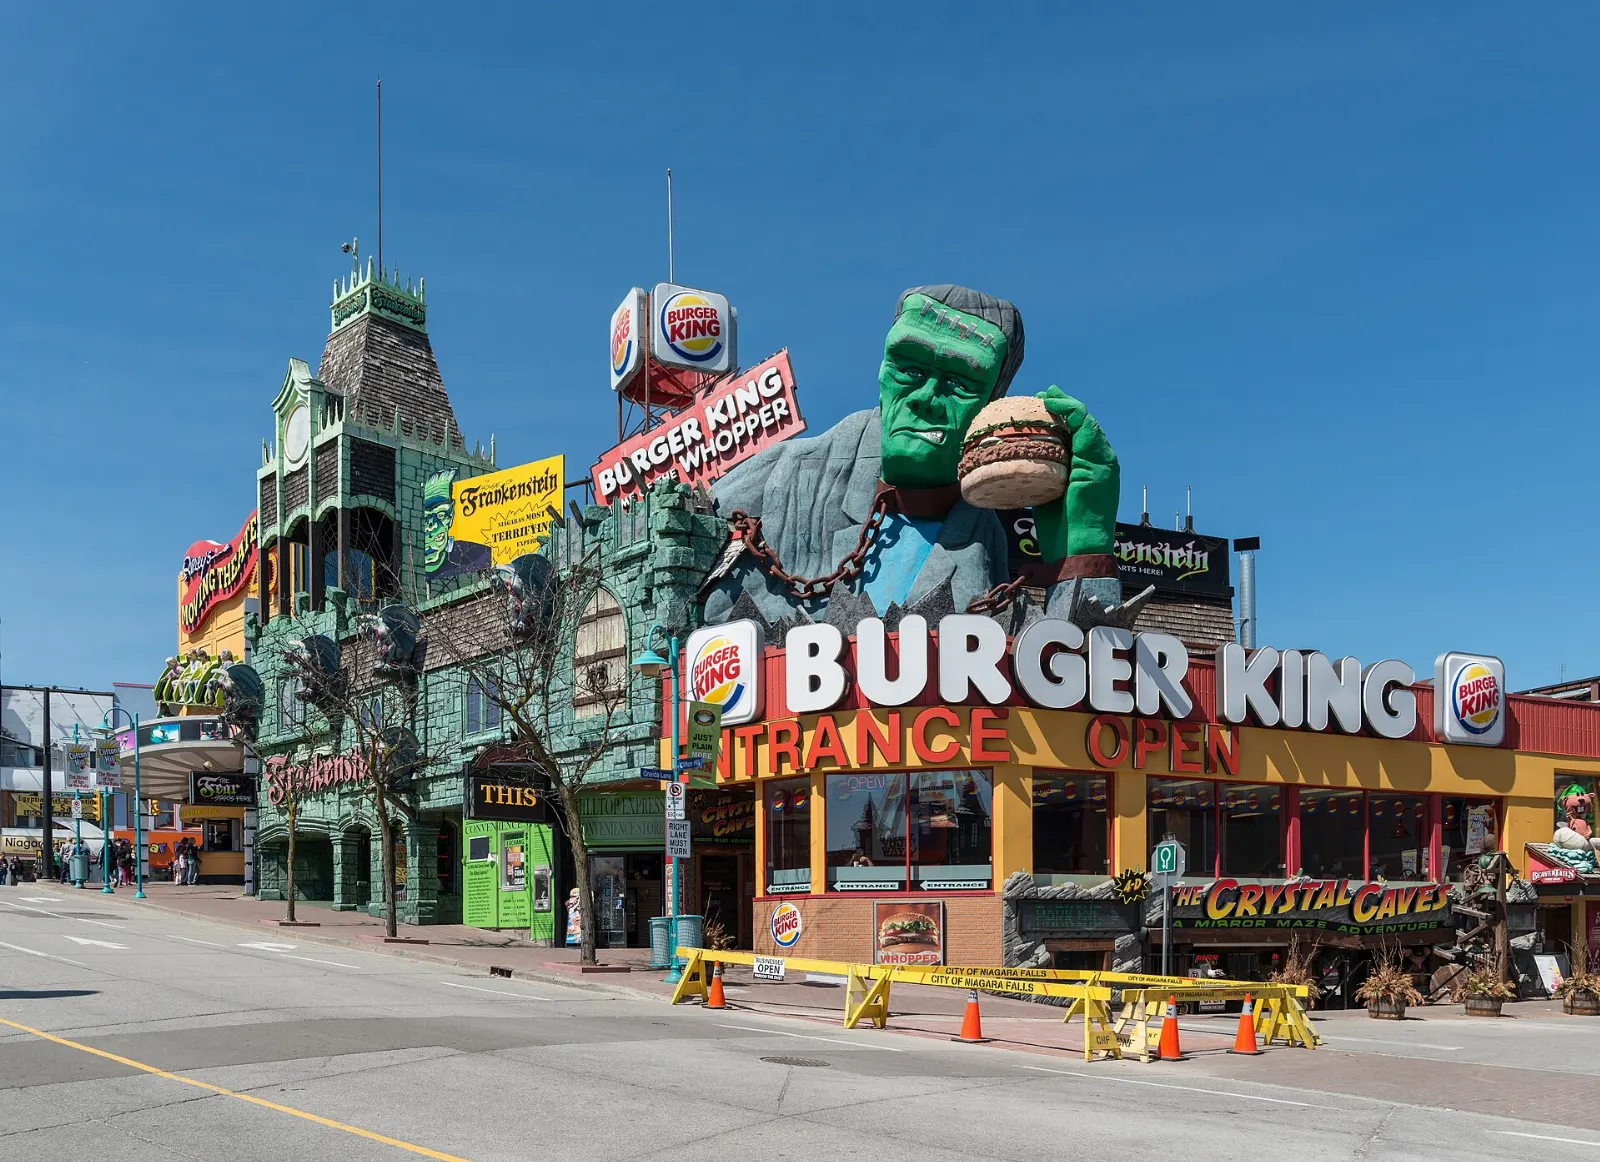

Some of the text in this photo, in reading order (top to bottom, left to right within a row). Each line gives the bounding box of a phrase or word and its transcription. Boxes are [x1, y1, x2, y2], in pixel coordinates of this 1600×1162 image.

[668, 306, 718, 325] BURGER
[670, 319, 720, 343] KING
[704, 366, 782, 431] KING
[678, 397, 789, 473] WHOPPER
[598, 417, 703, 497] BURGER
[460, 467, 558, 517] Frankenstein
[526, 510, 545, 521] MOST
[491, 520, 550, 543] TERRIFYIN
[216, 515, 257, 589] THEATE
[1139, 567, 1163, 576] HERE!
[181, 568, 216, 626] MOVING
[694, 645, 739, 682] BURGER
[696, 658, 740, 702] KING
[785, 613, 1417, 739] BURGER KING
[1459, 675, 1498, 700] BURGER
[1461, 688, 1500, 719] KING
[693, 733, 713, 741] JUST
[1085, 714, 1239, 775] OPEN
[692, 751, 712, 760] MORE
[197, 776, 241, 798] Fear
[847, 775, 886, 790] OPEN
[19, 795, 44, 803] Egyptia
[480, 784, 537, 807] THIS
[622, 797, 665, 815] EXPRESS
[702, 800, 756, 824] CRYST
[669, 822, 689, 831] RIGHT
[713, 816, 756, 837] CAVE
[5, 838, 44, 849] Niagar
[927, 881, 985, 889] ENTRANCE
[1172, 886, 1203, 908] THE
[1206, 878, 1453, 923] CRYSTAL CAVES
[773, 909, 798, 927] BURGER
[774, 918, 799, 937] KING
[1173, 920, 1183, 928] A
[1277, 918, 1327, 930] MAZE
[1338, 920, 1438, 935] ADVENTURE
[756, 957, 784, 966] BUSINESSES
[880, 954, 939, 964] WHOPPER
[758, 964, 781, 975] OPEN
[945, 967, 965, 975] CITY
[980, 968, 1019, 977] NIAGARA
[931, 974, 1034, 992] CITY OF NIAGARA FALLS
[1096, 1035, 1110, 1045] CNF
